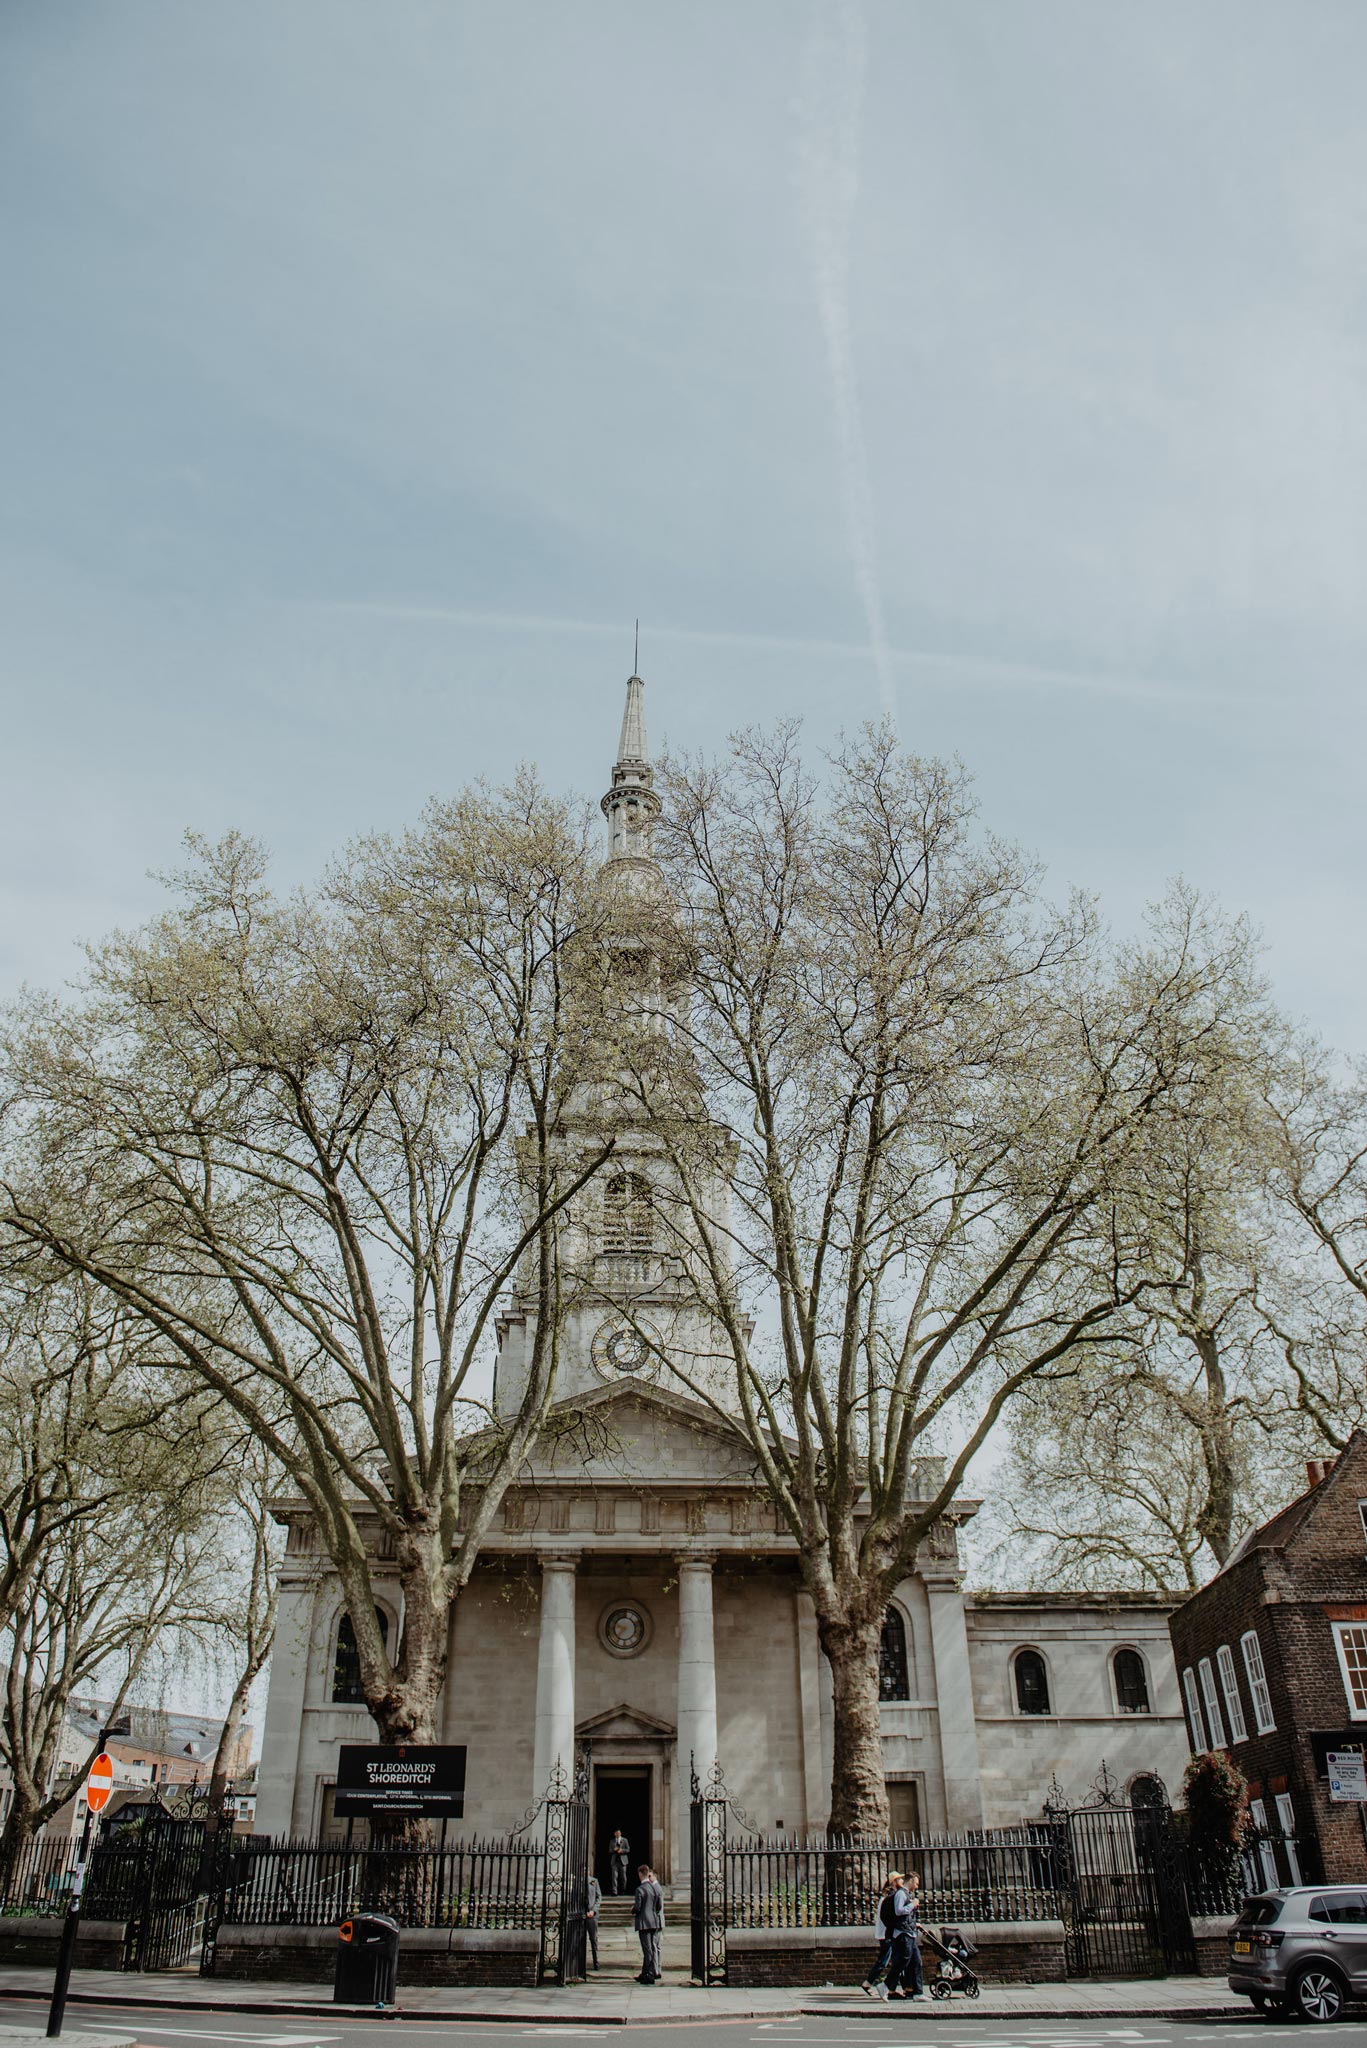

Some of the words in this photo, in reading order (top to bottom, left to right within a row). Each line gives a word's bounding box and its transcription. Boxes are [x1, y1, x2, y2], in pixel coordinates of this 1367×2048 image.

[366, 1763, 379, 1773] ST
[379, 1763, 436, 1773] LEONARD'S
[369, 1773, 431, 1783] SHOREDITCH
